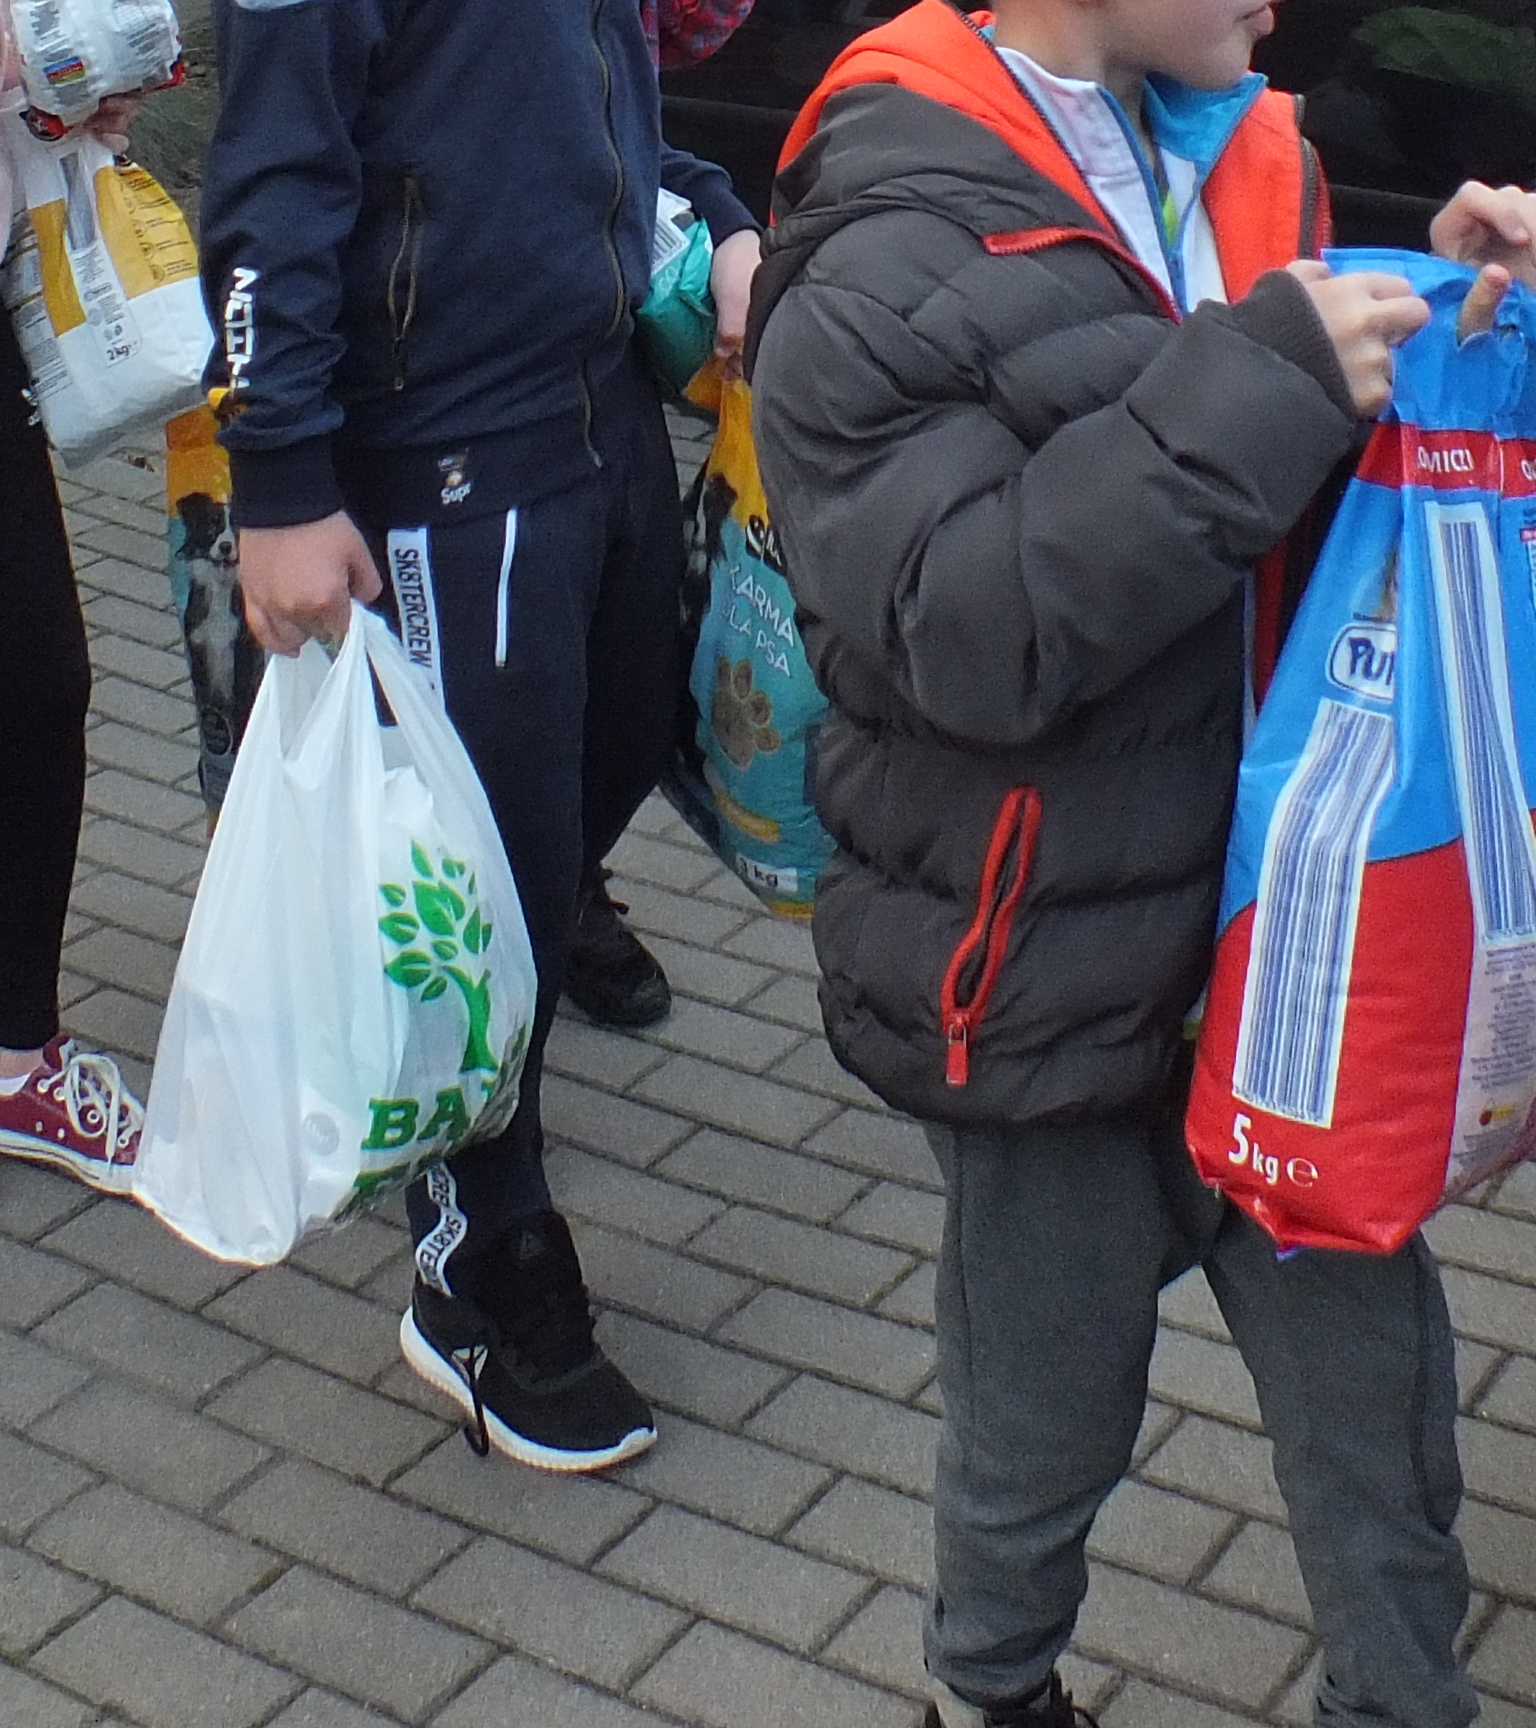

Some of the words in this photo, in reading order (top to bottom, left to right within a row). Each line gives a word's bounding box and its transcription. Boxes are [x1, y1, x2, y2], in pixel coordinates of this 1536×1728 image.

[394, 548, 433, 669] SK8TERCREW
[755, 629, 791, 678] PSA
[1228, 1112, 1252, 1165] 5
[1252, 1142, 1280, 1185] kg
